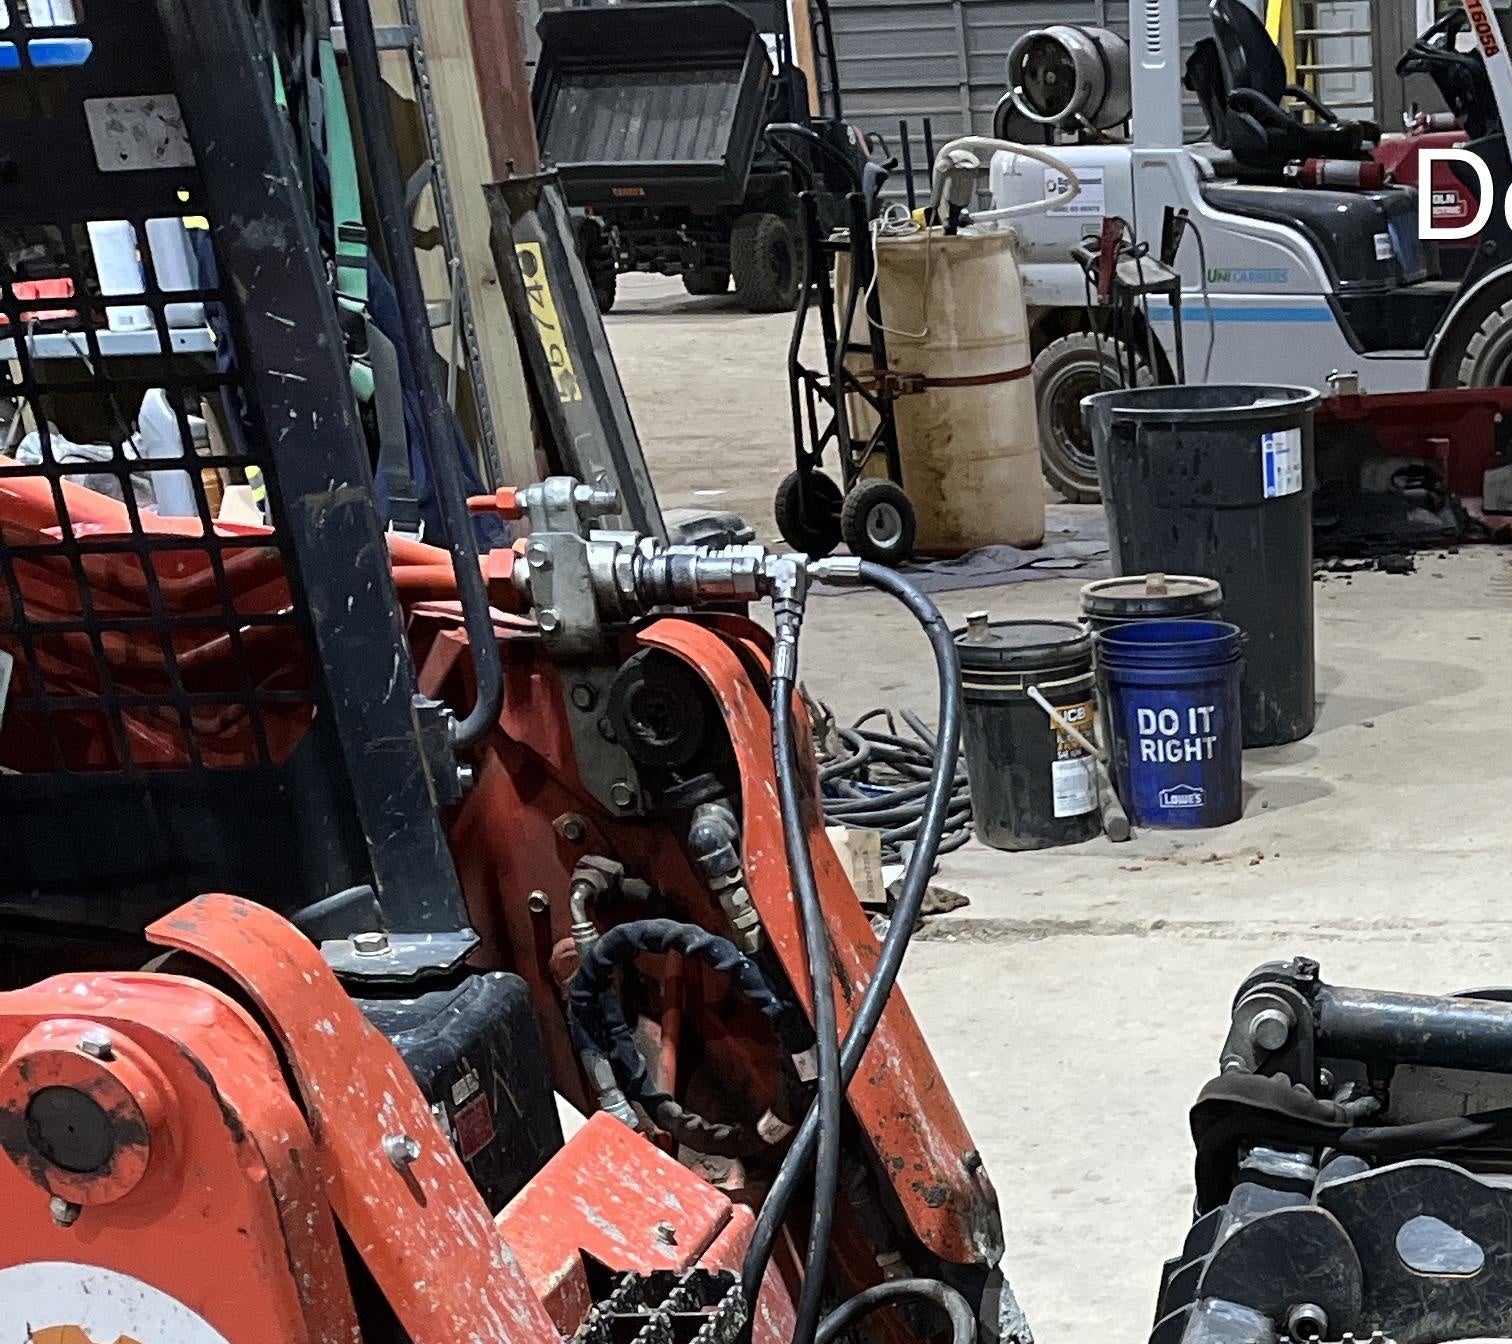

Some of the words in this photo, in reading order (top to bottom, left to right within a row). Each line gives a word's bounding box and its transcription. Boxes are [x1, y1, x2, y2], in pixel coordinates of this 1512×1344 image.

[1137, 708, 1180, 736] DO
[1188, 705, 1215, 735] IT
[1140, 736, 1217, 763] RIGHT
[1163, 793, 1203, 805] LOWE'S
